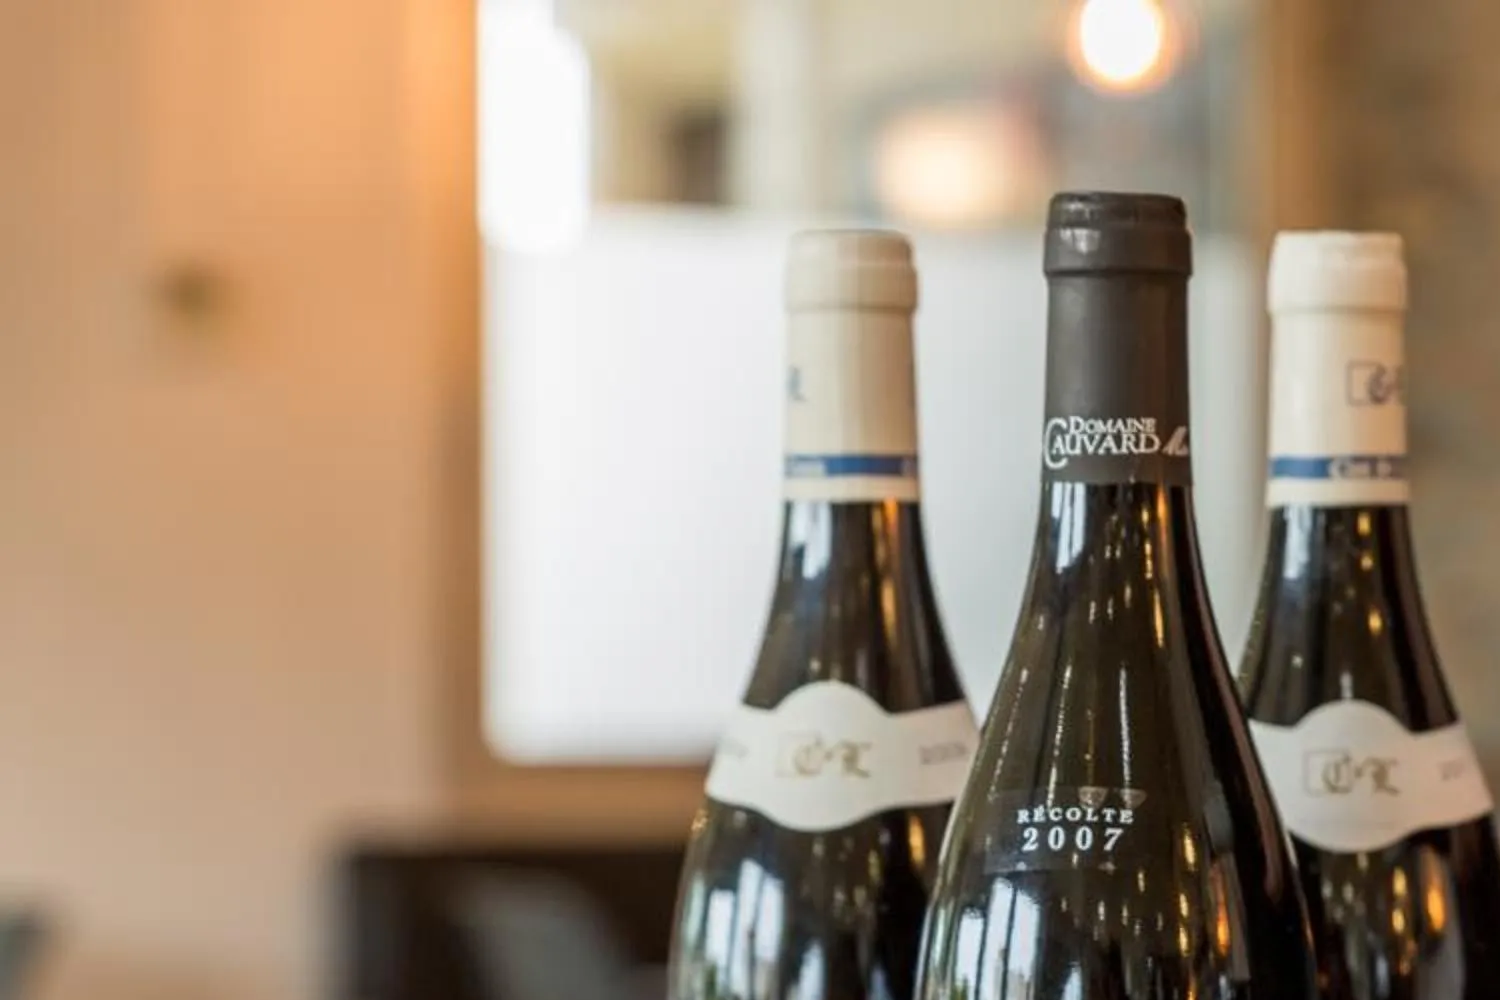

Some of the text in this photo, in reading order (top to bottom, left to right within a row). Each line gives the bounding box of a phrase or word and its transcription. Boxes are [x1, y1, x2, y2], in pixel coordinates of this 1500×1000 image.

[1069, 416, 1157, 434] DOMAINE
[1044, 417, 1162, 469] CAUVARD
[1022, 826, 1123, 851] 2007
